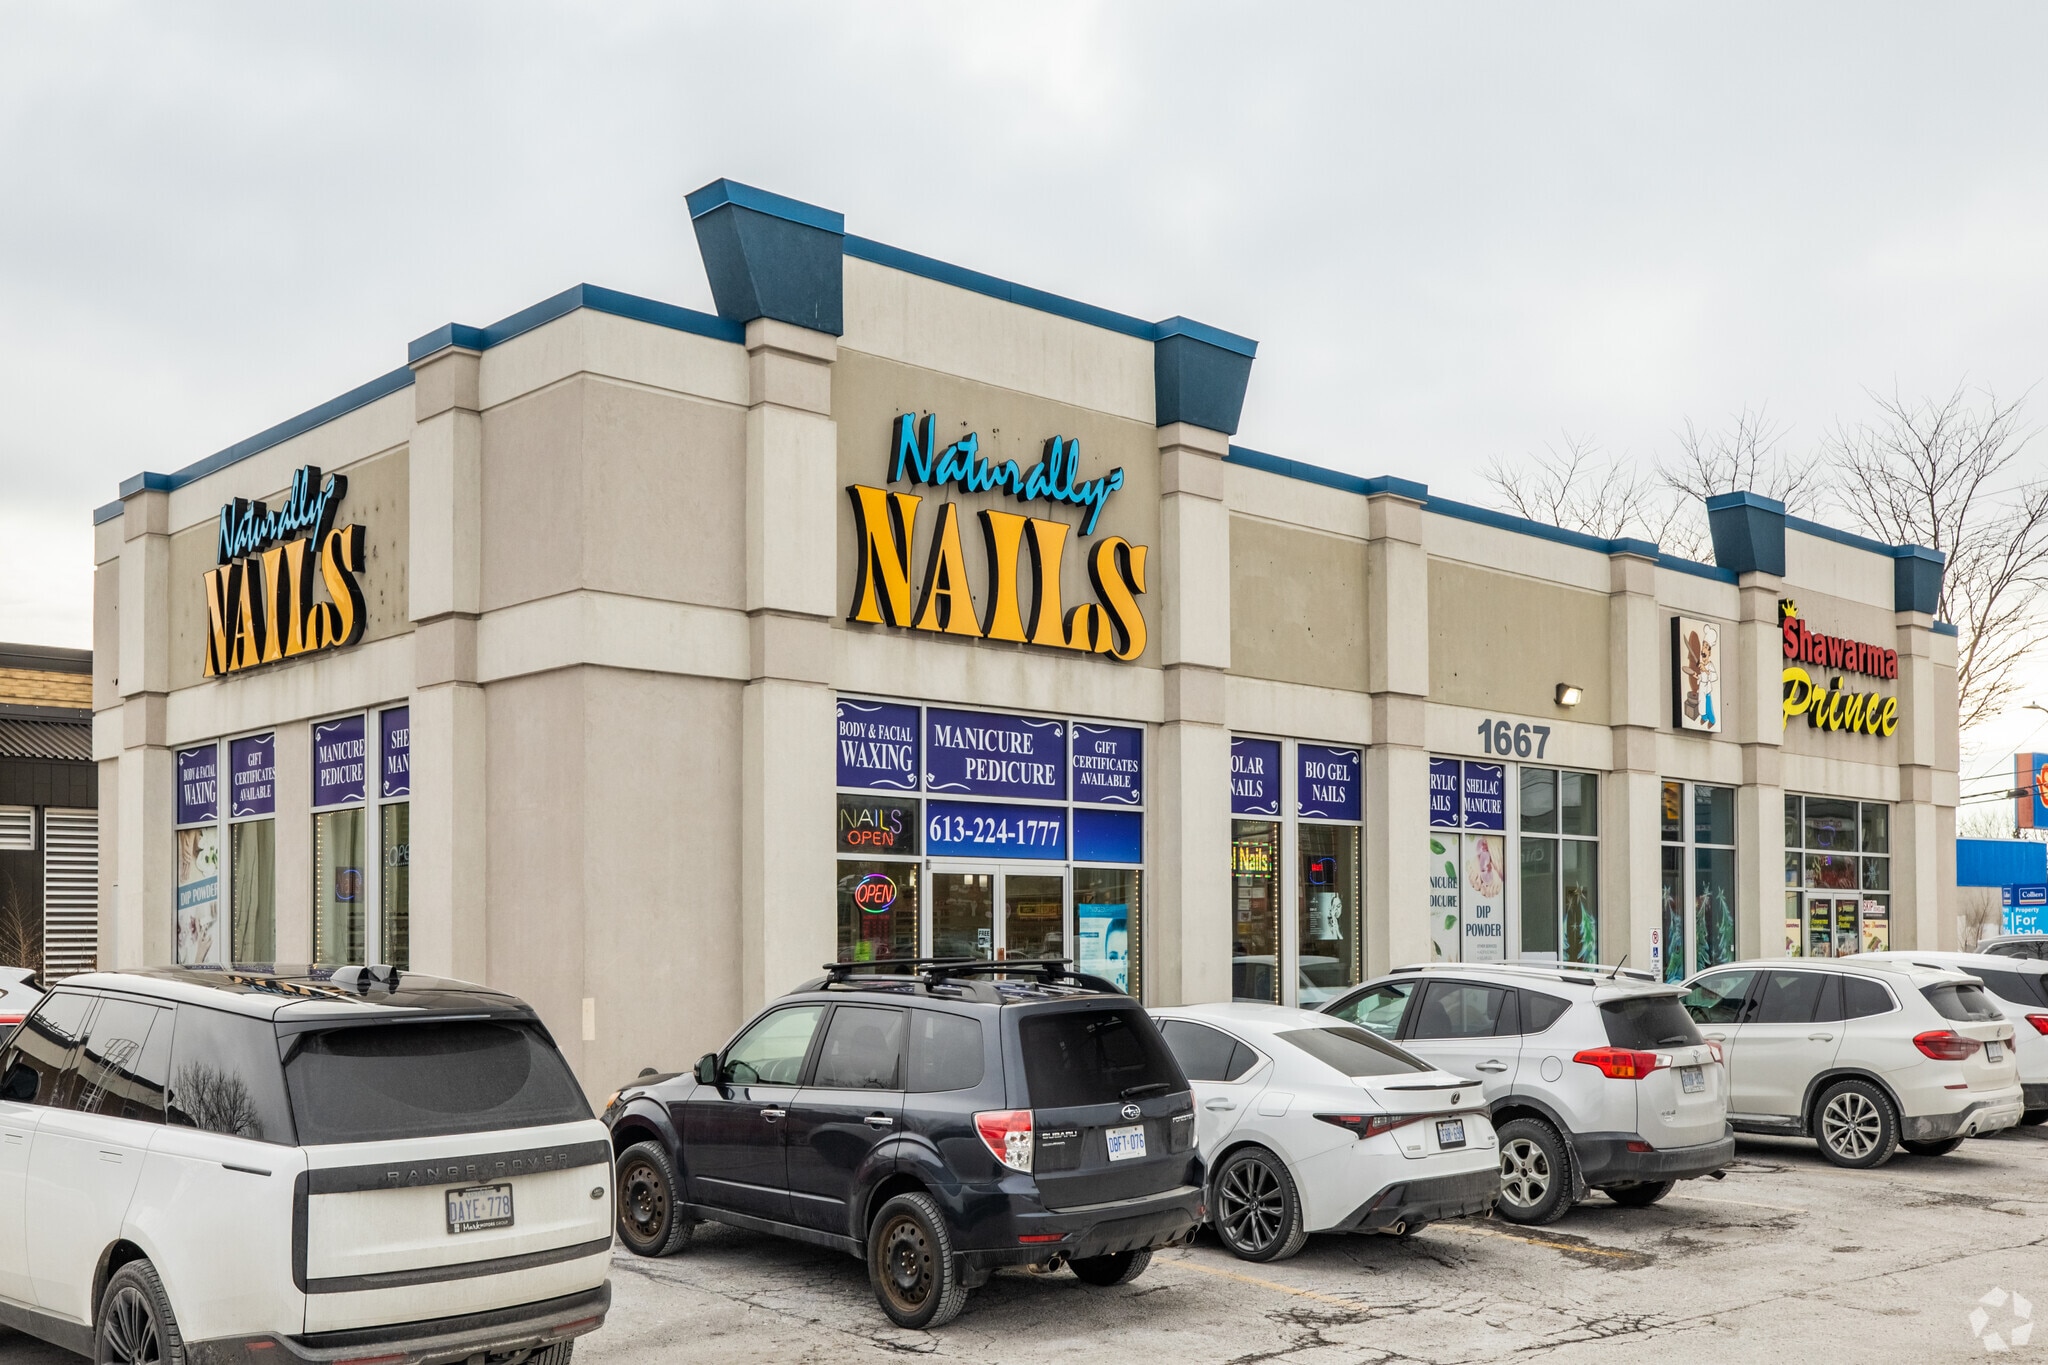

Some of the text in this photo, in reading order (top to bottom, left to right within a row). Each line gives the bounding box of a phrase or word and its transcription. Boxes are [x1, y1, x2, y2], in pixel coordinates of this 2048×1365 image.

[892, 412, 1124, 537] Naturally
[217, 464, 341, 566] Naturally
[850, 484, 1149, 662] NAILS
[203, 523, 360, 678] NAILS
[1783, 615, 1899, 680] Shawarma
[1782, 666, 1899, 737] Prince
[391, 728, 409, 749] SHE
[839, 720, 913, 742] BODY & FACIAL
[934, 723, 1034, 755] MANICURE
[1478, 718, 1551, 760] 1667
[319, 738, 365, 764] MANICURE
[841, 740, 913, 772] WAXING
[1094, 740, 1117, 755] GIFT
[247, 752, 263, 767] GIFT
[387, 753, 409, 775] MAN
[1072, 754, 1139, 773] CERTIFICATES
[1231, 755, 1264, 775] OLAR
[183, 767, 196, 782] BODY
[200, 763, 216, 779] FACIAL
[234, 766, 275, 786] CERTIFICATES
[321, 763, 363, 787] PEDICURE
[965, 757, 1056, 786] PEDICURE
[1080, 771, 1131, 788] AVAILABLE
[1305, 761, 1351, 781] BIO GEL
[183, 779, 216, 806] WAXING
[1430, 773, 1457, 792] RYLIC
[1466, 778, 1499, 796] SHELLAC
[239, 784, 272, 802] AVAILABLE
[1312, 784, 1346, 803] NAILS
[1430, 794, 1451, 812] AILS
[1465, 797, 1502, 815] MANICURE
[840, 808, 902, 835] NAILS
[929, 815, 1060, 847] 613-224-1777
[847, 830, 894, 847] OPEN
[1239, 847, 1268, 871] Nails
[1430, 876, 1458, 889] NICURE
[180, 888, 192, 906] DIP
[858, 883, 894, 904] OPEN
[1430, 894, 1458, 908] DICURE
[1476, 905, 1491, 919] DIP
[2015, 914, 2037, 926] For
[1466, 923, 1501, 937] POWDER
[2016, 926, 2044, 935] Sale
[1042, 1131, 1077, 1140] SUBARU
[387, 1153, 568, 1182] RANGE ROVER
